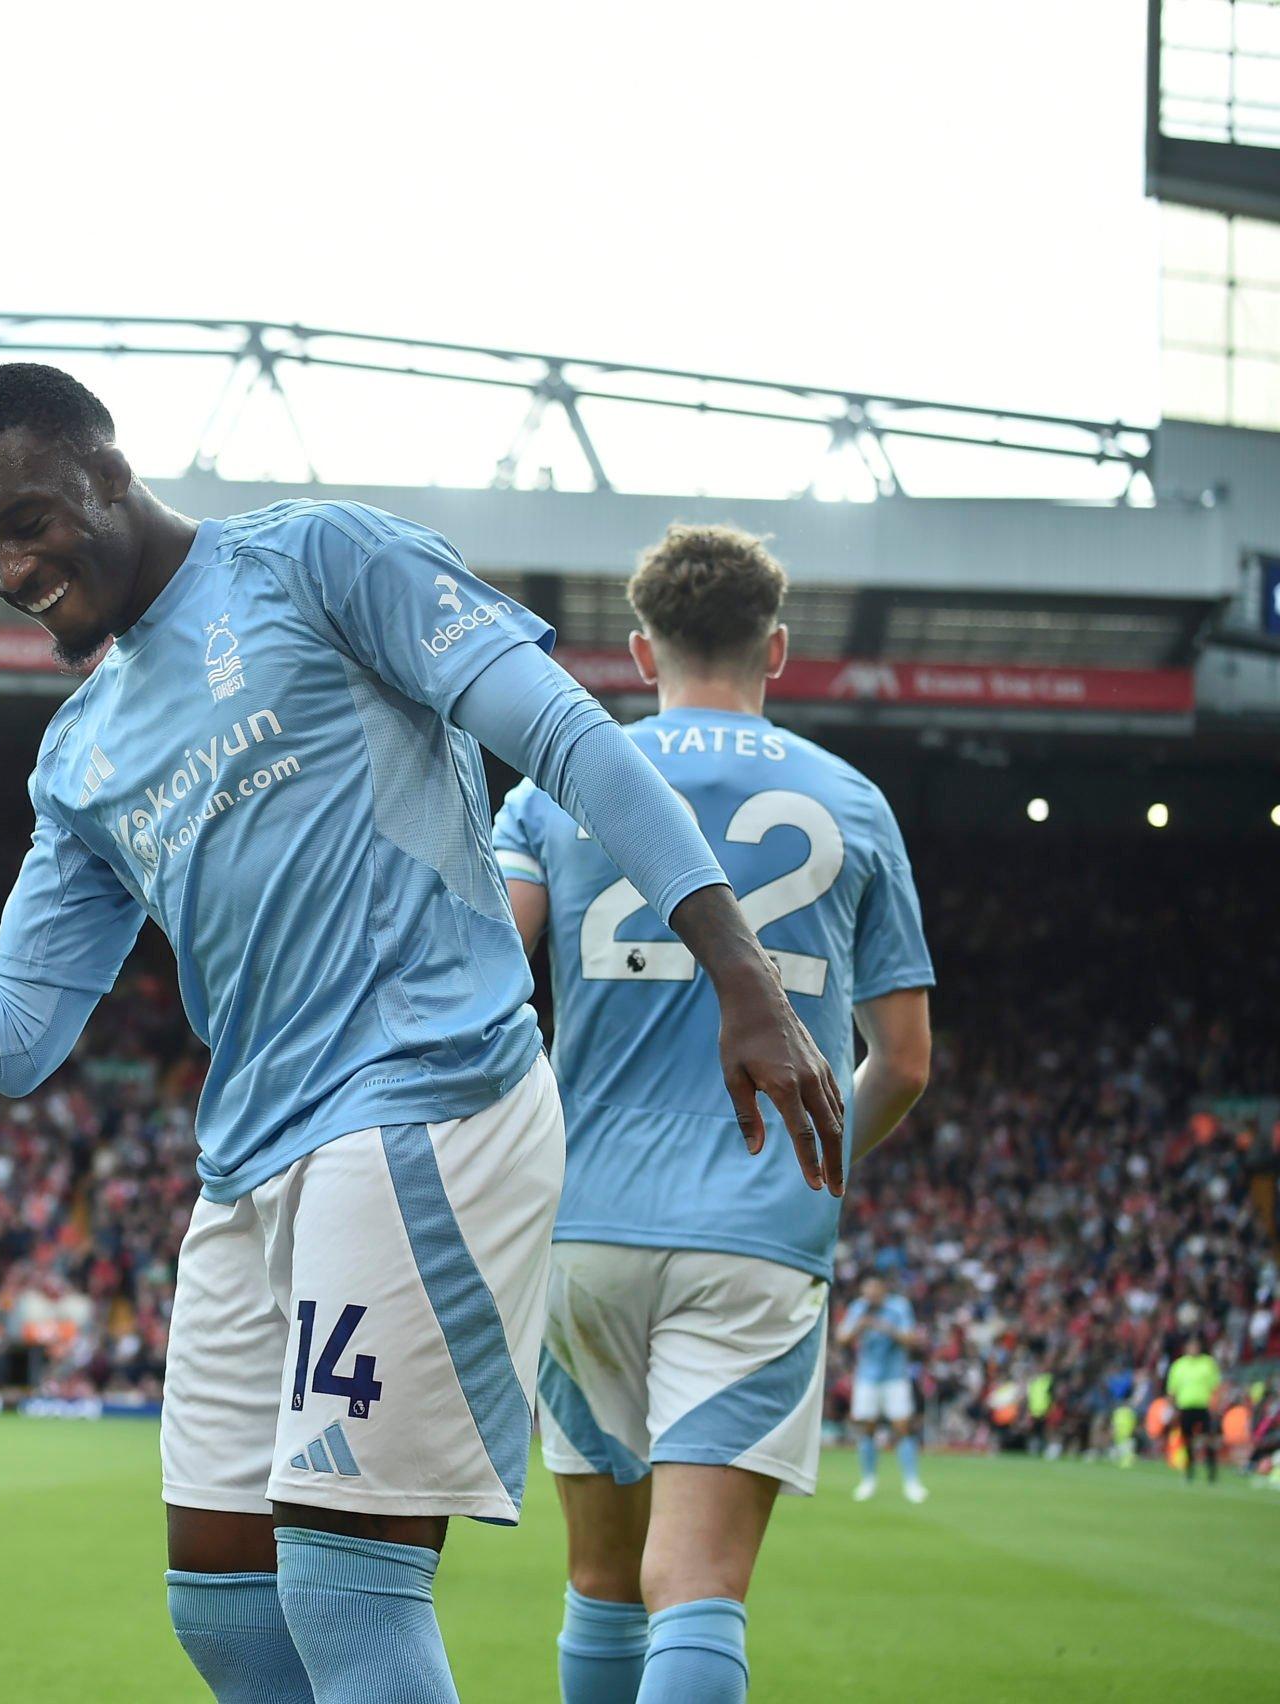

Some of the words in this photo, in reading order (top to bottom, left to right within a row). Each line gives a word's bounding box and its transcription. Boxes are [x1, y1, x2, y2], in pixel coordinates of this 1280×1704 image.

[145, 709, 282, 820] kaiyun
[655, 726, 786, 761] YATES
[577, 789, 845, 997] 22
[290, 1299, 382, 1419] 14
